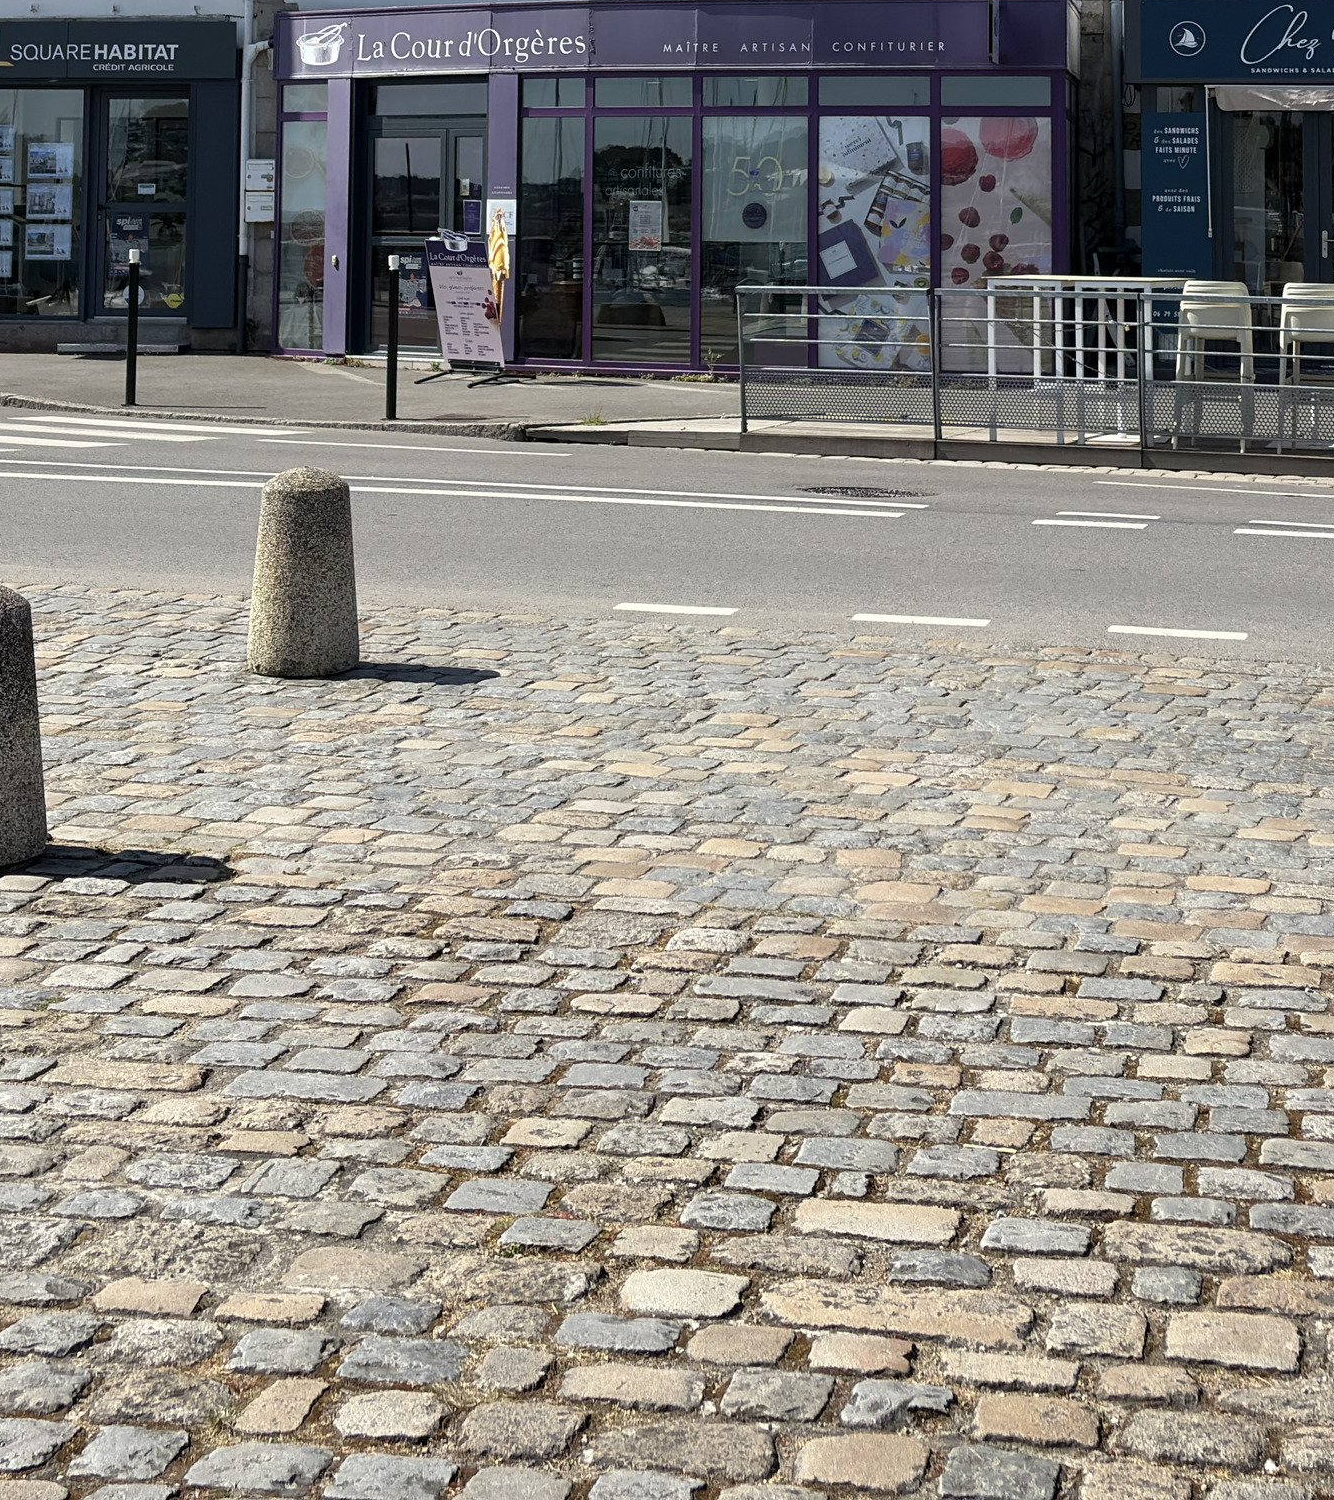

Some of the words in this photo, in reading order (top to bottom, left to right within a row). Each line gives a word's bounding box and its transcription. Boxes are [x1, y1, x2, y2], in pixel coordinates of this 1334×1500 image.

[1240, 4, 1321, 65] Chez
[357, 33, 384, 61] La
[390, 31, 454, 60] Cour
[458, 27, 587, 63] d'Orgères
[662, 41, 720, 53] MAÎTRE
[739, 42, 812, 53] ARTISAN
[831, 41, 946, 52] CONFITURIER
[92, 62, 126, 71] CRÉDIT
[128, 63, 174, 72] AGRICOLE
[620, 163, 683, 179] confitures
[429, 252, 438, 261] La
[438, 252, 455, 262] Cour
